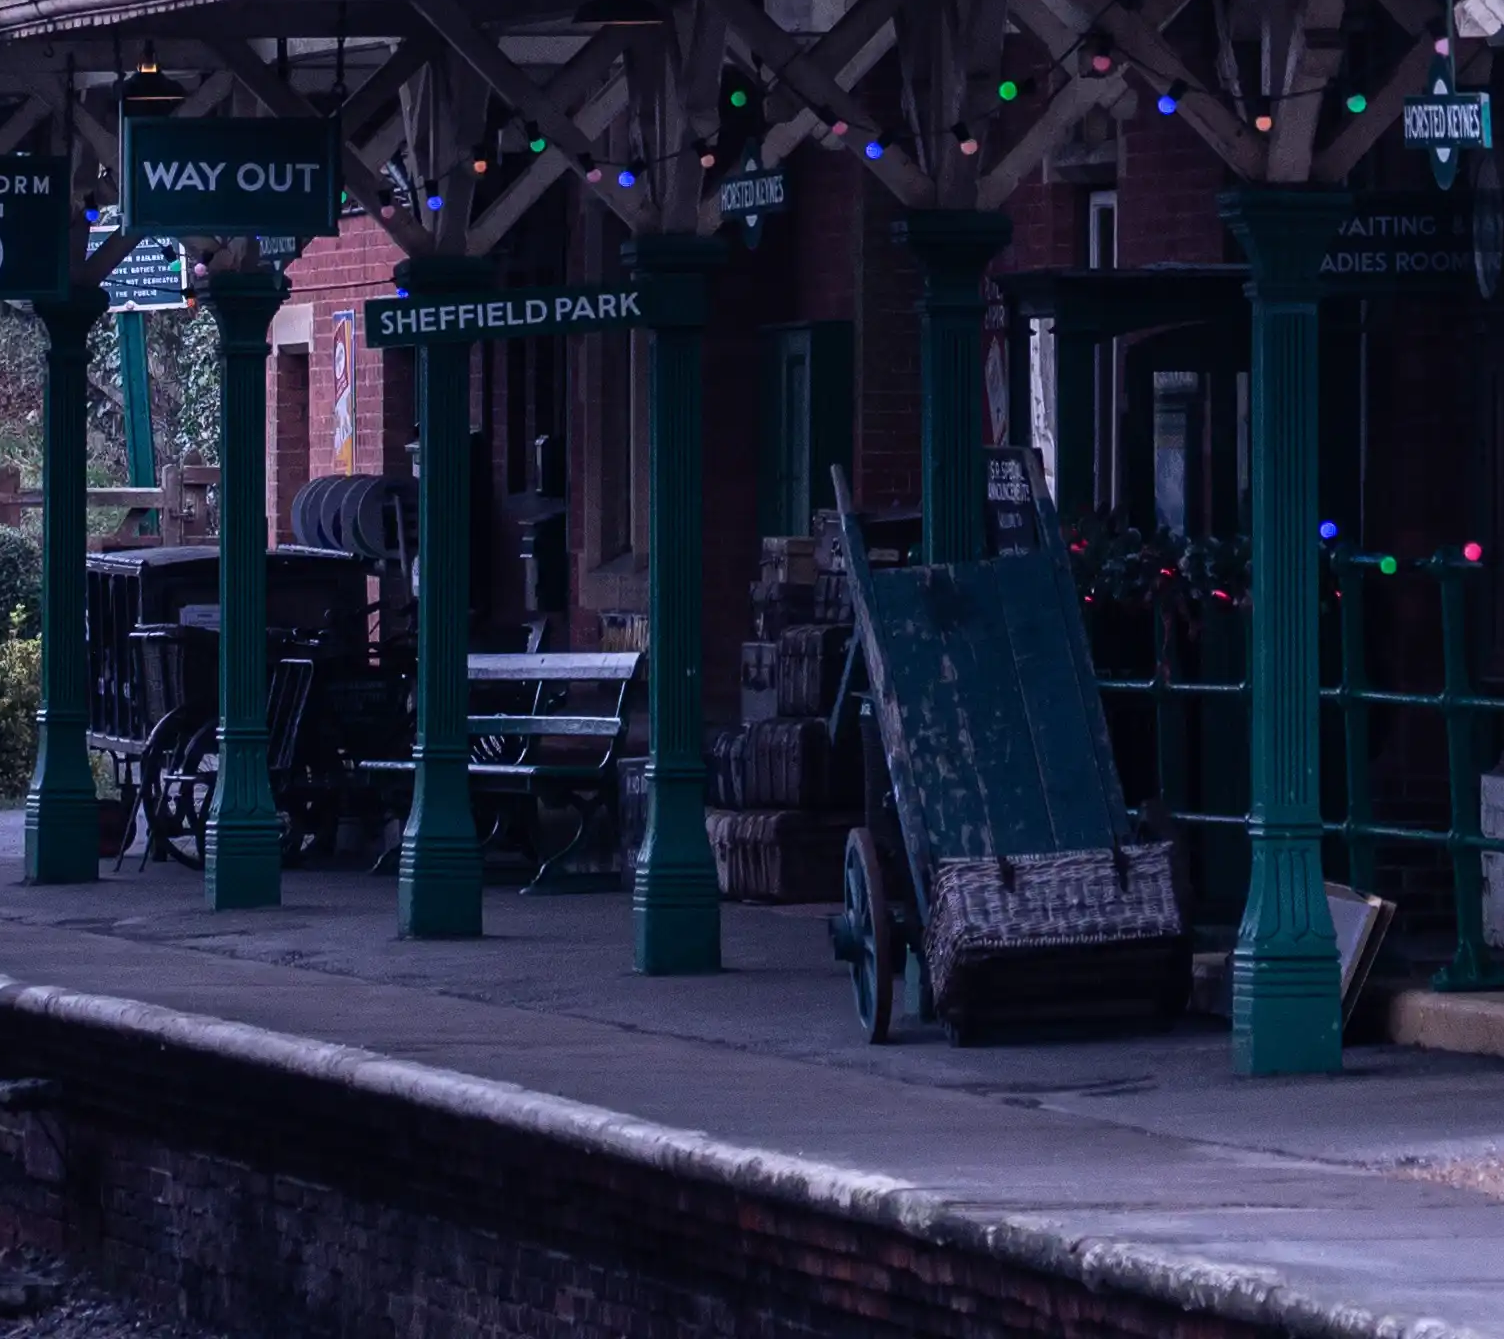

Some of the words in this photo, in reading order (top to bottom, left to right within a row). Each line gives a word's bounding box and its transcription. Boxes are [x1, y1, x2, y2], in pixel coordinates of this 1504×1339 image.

[1404, 105, 1446, 140] HORSTED
[1447, 104, 1480, 139] KEYNES
[143, 161, 227, 191] WAY
[236, 163, 320, 193] OUT
[131, 266, 156, 274] NOTICE
[1319, 251, 1388, 273] ADIES
[1395, 251, 1470, 273] ROOM
[143, 277, 179, 285] DEDICATED
[133, 289, 157, 297] PUBLIC
[380, 299, 547, 335] SHEFFIELD
[555, 291, 642, 321] PARK
